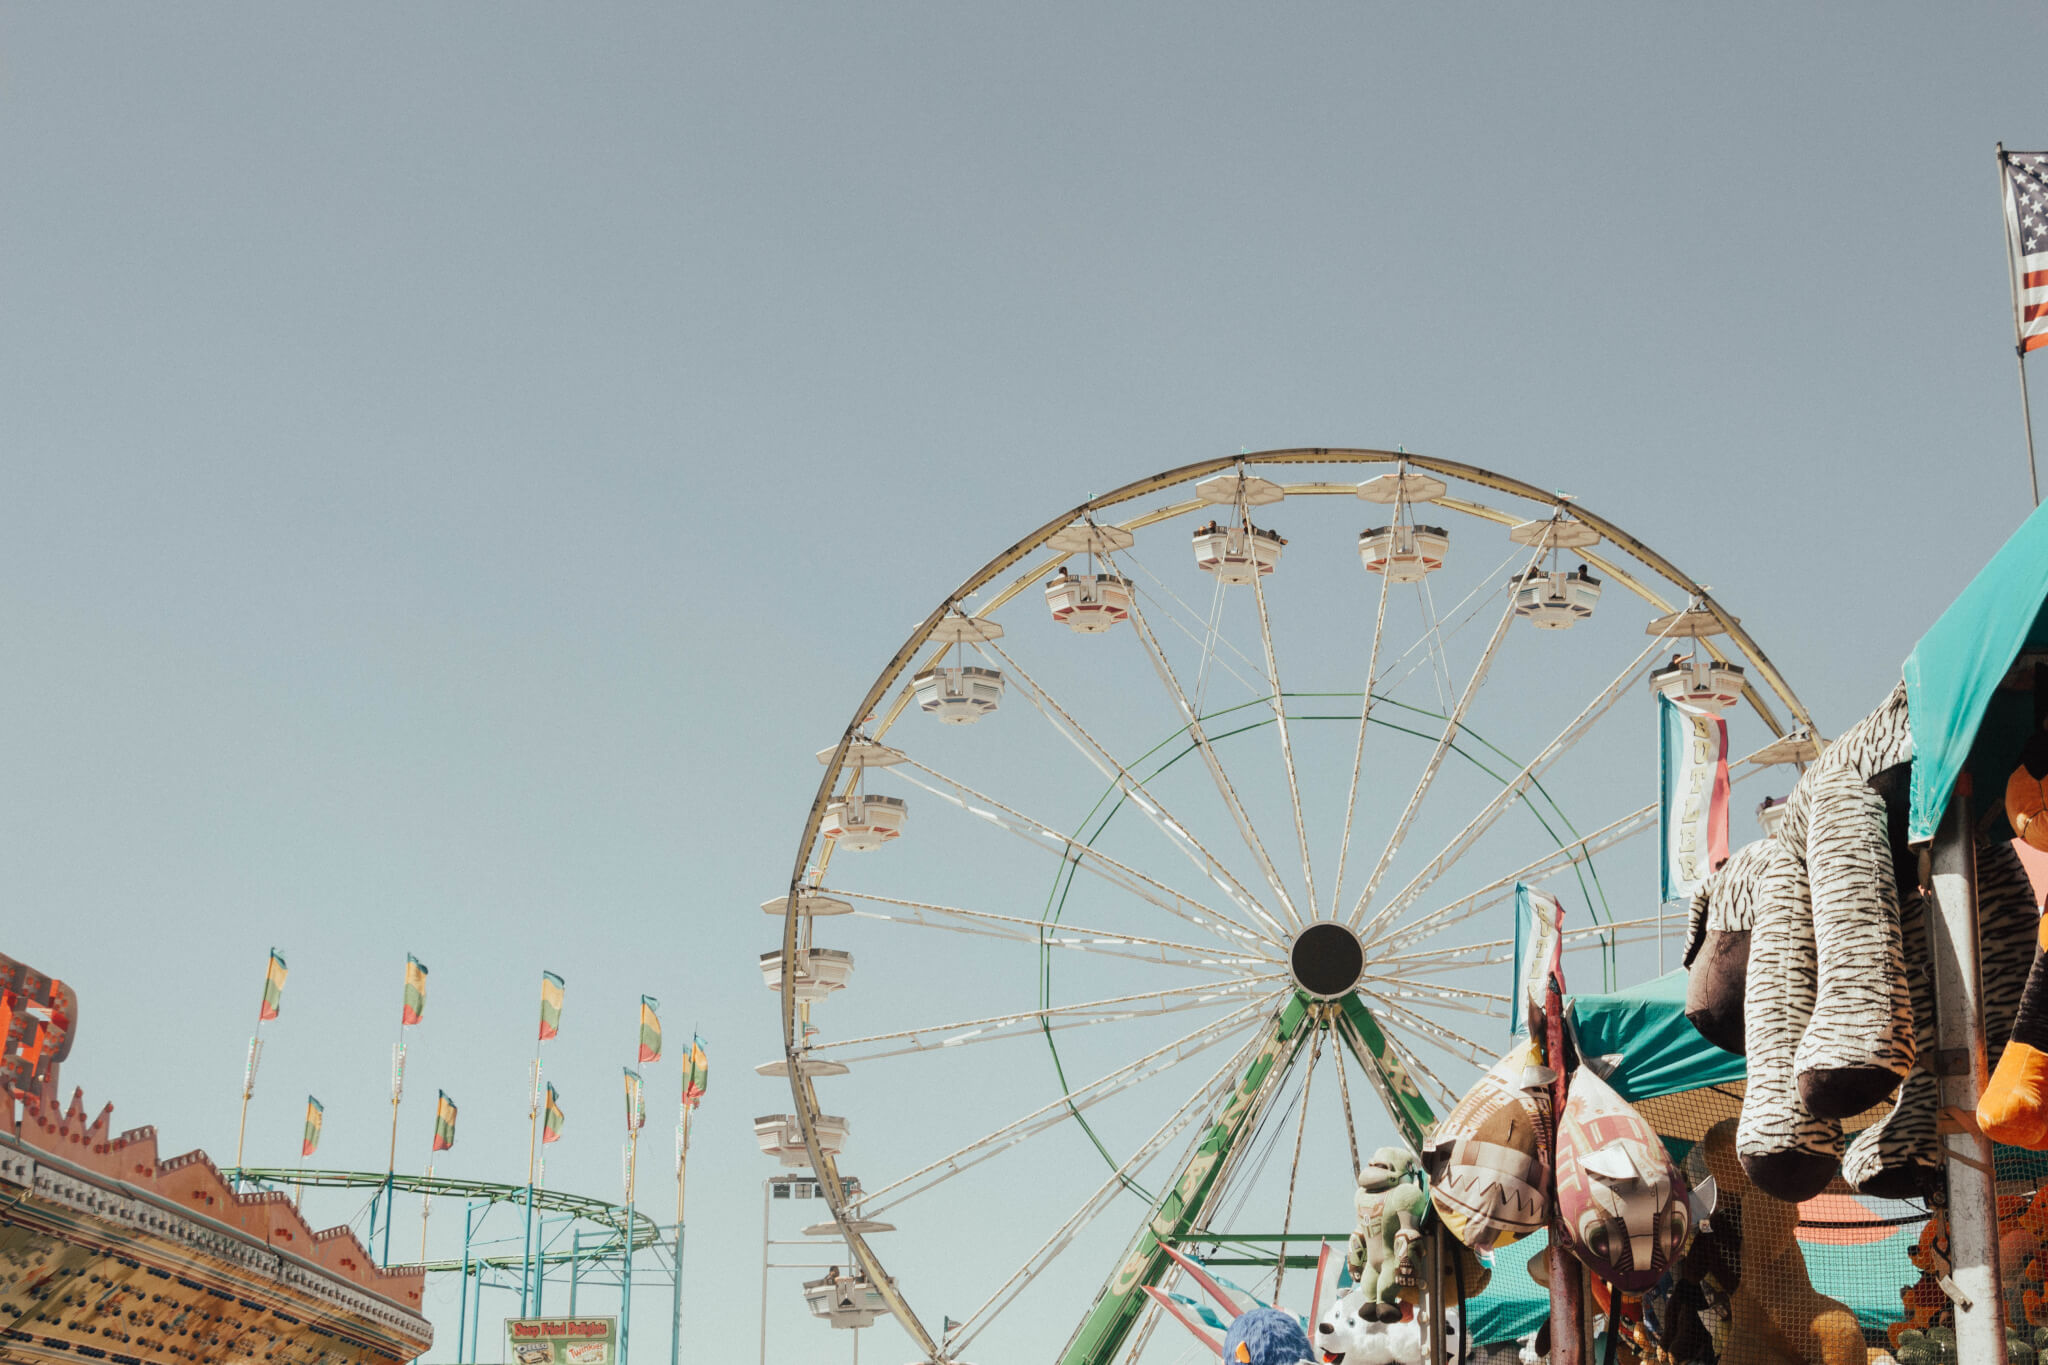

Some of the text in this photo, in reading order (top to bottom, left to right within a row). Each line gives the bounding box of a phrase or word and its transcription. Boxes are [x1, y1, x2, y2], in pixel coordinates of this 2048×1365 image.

[1678, 715, 1710, 882] BUTLER
[1112, 1022, 1285, 1297] GIANT
[514, 1321, 607, 1338] Deep Fried Delights
